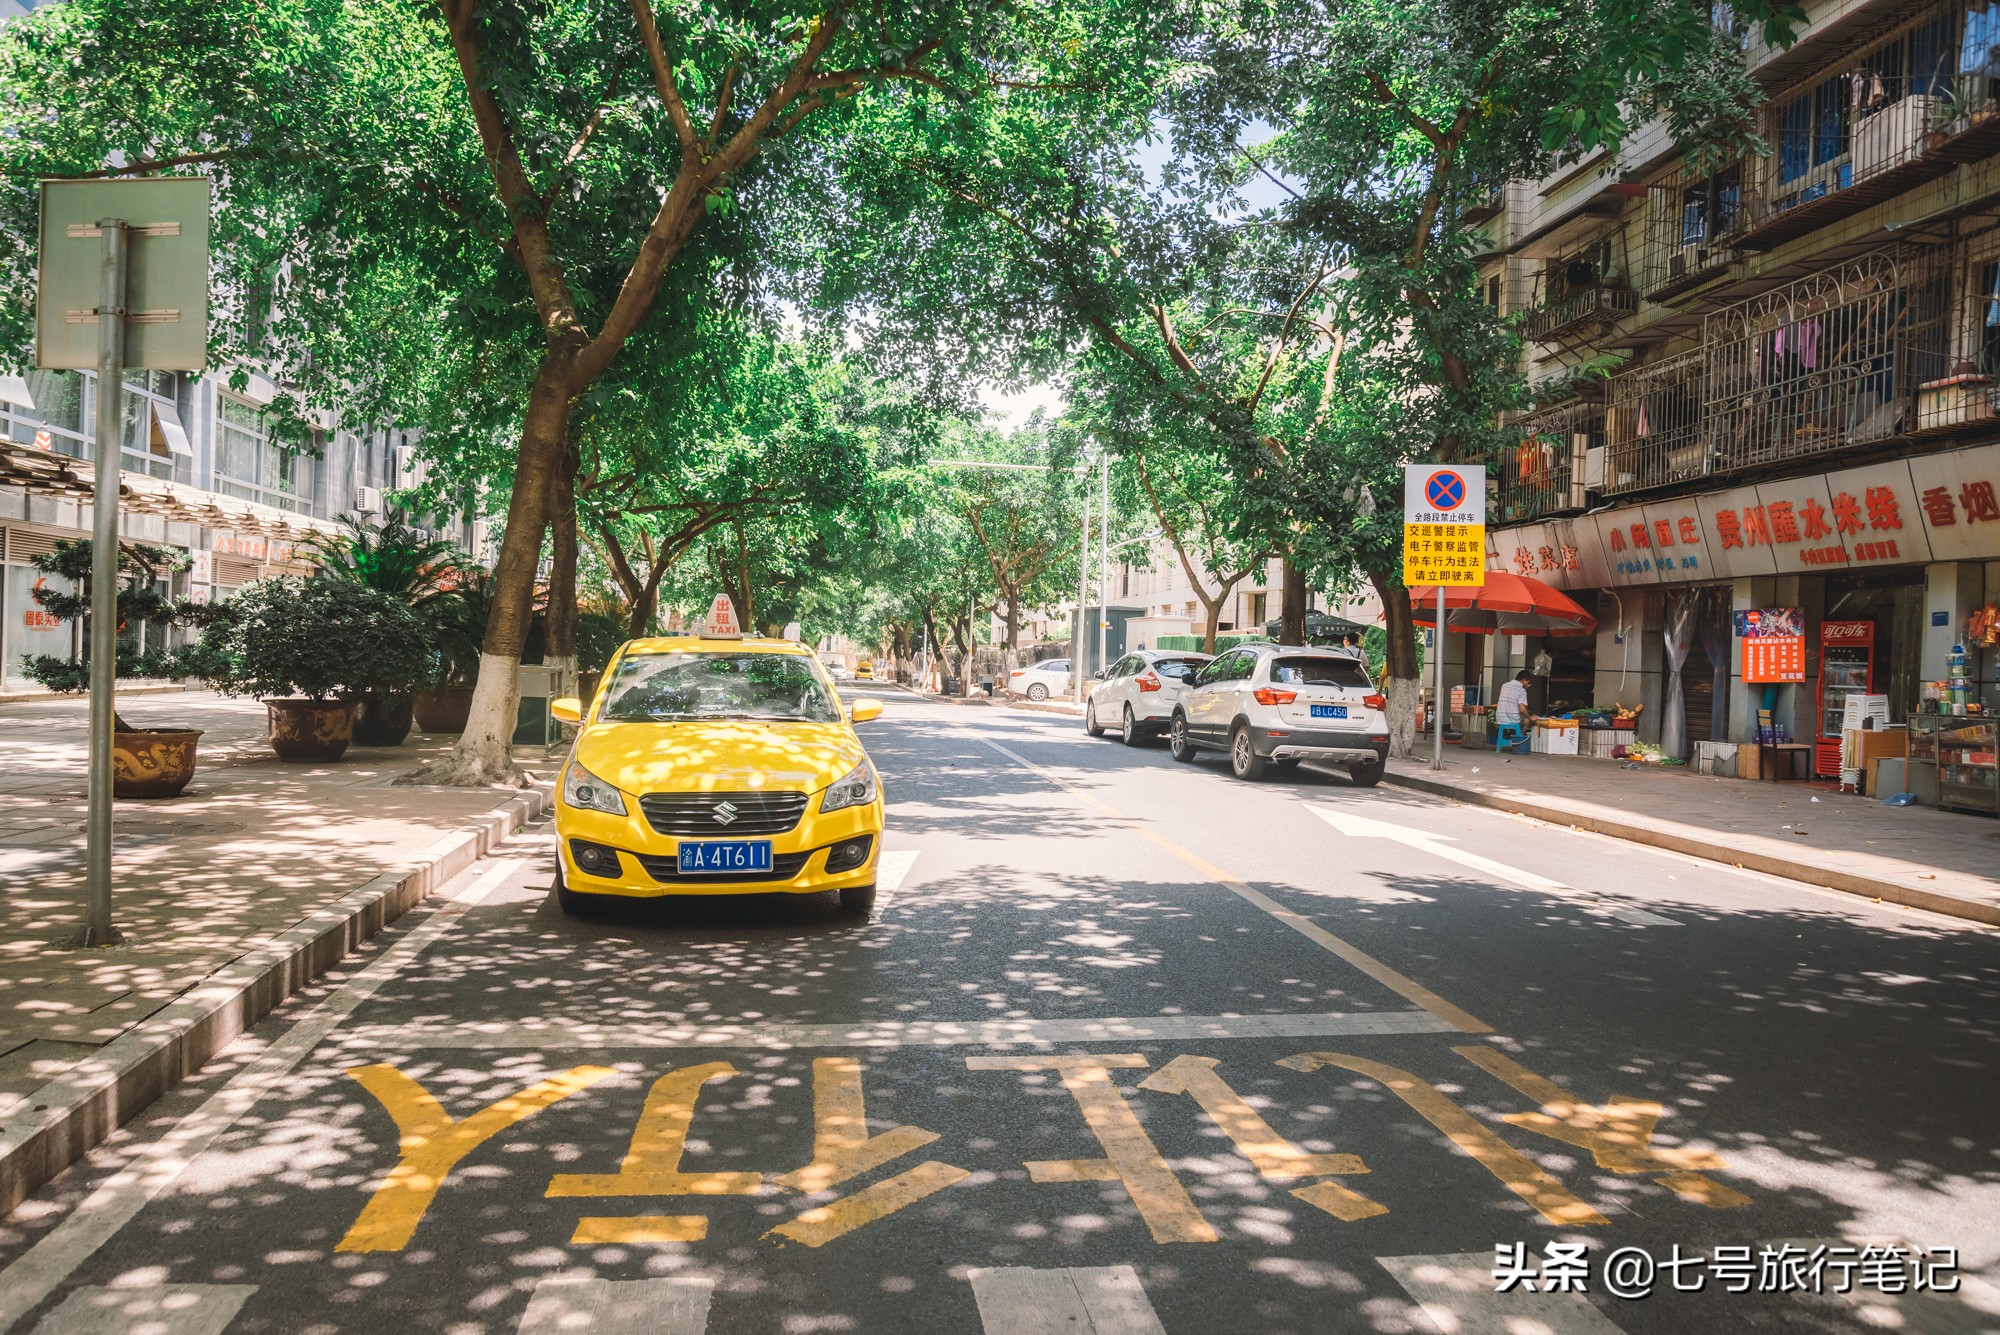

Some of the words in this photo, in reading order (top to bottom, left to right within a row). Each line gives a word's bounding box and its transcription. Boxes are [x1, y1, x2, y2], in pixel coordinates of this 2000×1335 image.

[1921, 480, 2000, 527] 香烟
[1414, 512, 1475, 522] 全路段禁止停车
[1715, 485, 1903, 549] 贵州蘸水米线
[1410, 540, 1479, 552] 电子警察监管
[1409, 556, 1480, 567] 停车行为违法
[1415, 570, 1474, 581] 请立即驶离
[25, 611, 61, 626] 国泰实业
[716, 600, 729, 624] 出租
[709, 626, 736, 634] TAXI
[1824, 623, 1868, 638] 可口可乐
[334, 1045, 1754, 1254] 礼让行人
